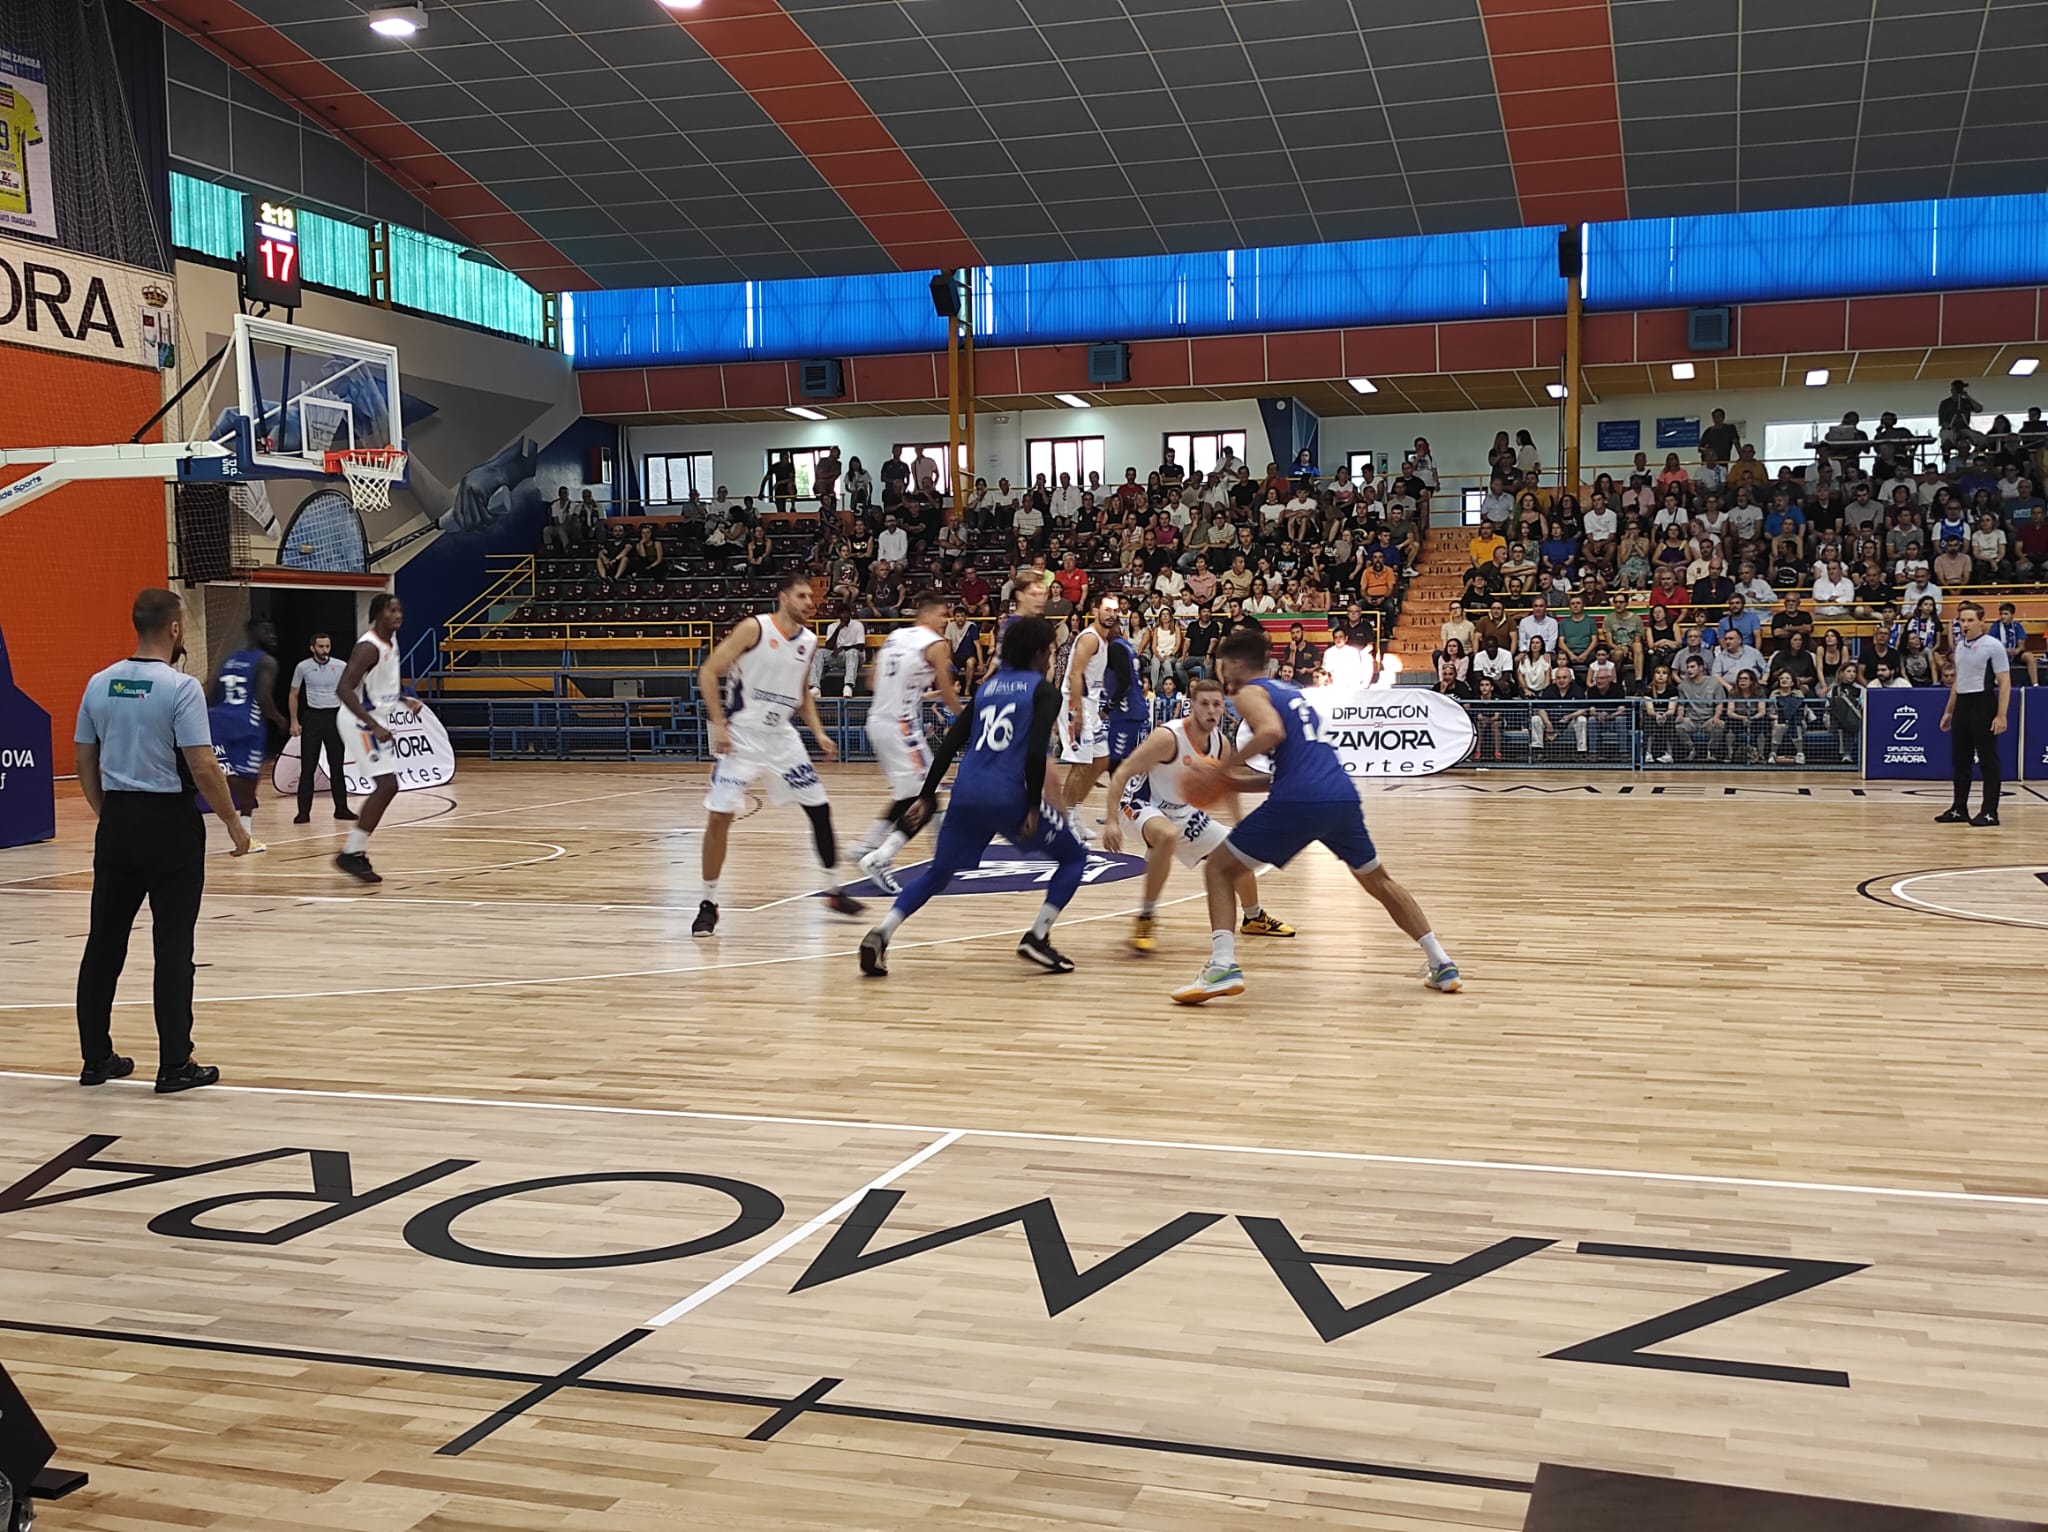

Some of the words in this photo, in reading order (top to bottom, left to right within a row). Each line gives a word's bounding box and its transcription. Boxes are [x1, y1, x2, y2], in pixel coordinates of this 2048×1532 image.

[260, 240, 294, 282] 17
[0, 490, 13, 500] de
[13, 476, 42, 494] Sports
[975, 702, 1017, 752] 16
[1326, 730, 1436, 750] ZAMORA
[1343, 759, 1435, 773] ortes
[1884, 754, 1927, 763] ZAMORA
[343, 767, 442, 792] Dertes
[1354, 783, 2017, 798] TAMIENTO
[0, 1134, 1873, 1388] ZAMORA
